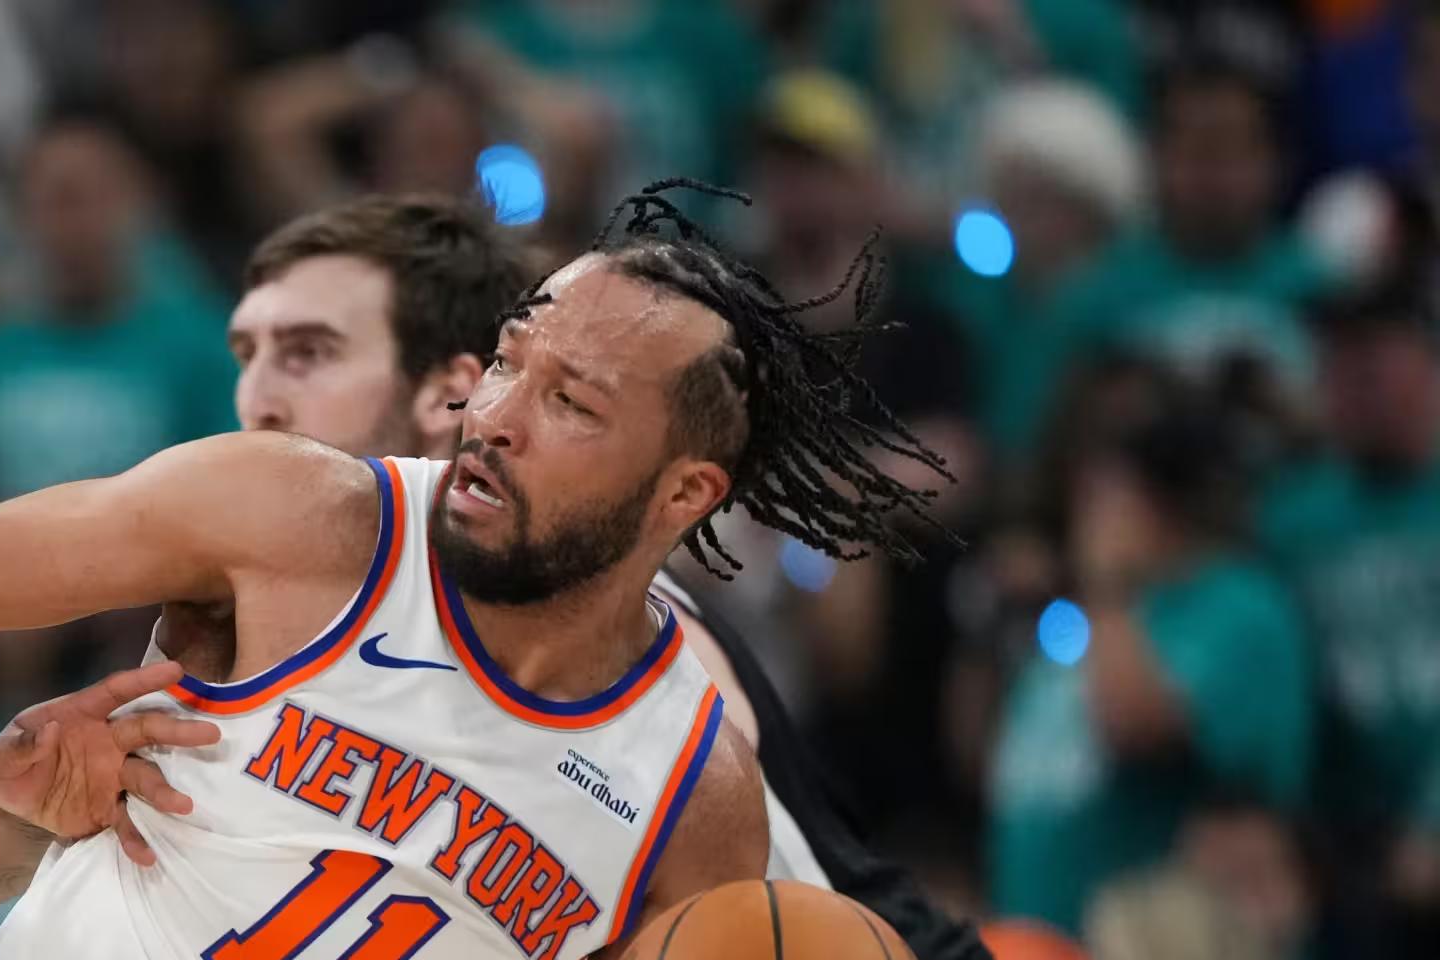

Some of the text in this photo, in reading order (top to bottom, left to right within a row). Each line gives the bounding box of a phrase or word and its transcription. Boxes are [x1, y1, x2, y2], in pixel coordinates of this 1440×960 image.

[241, 698, 457, 849] NEW
[557, 760, 641, 824] abu dhabi
[567, 748, 611, 782] experience
